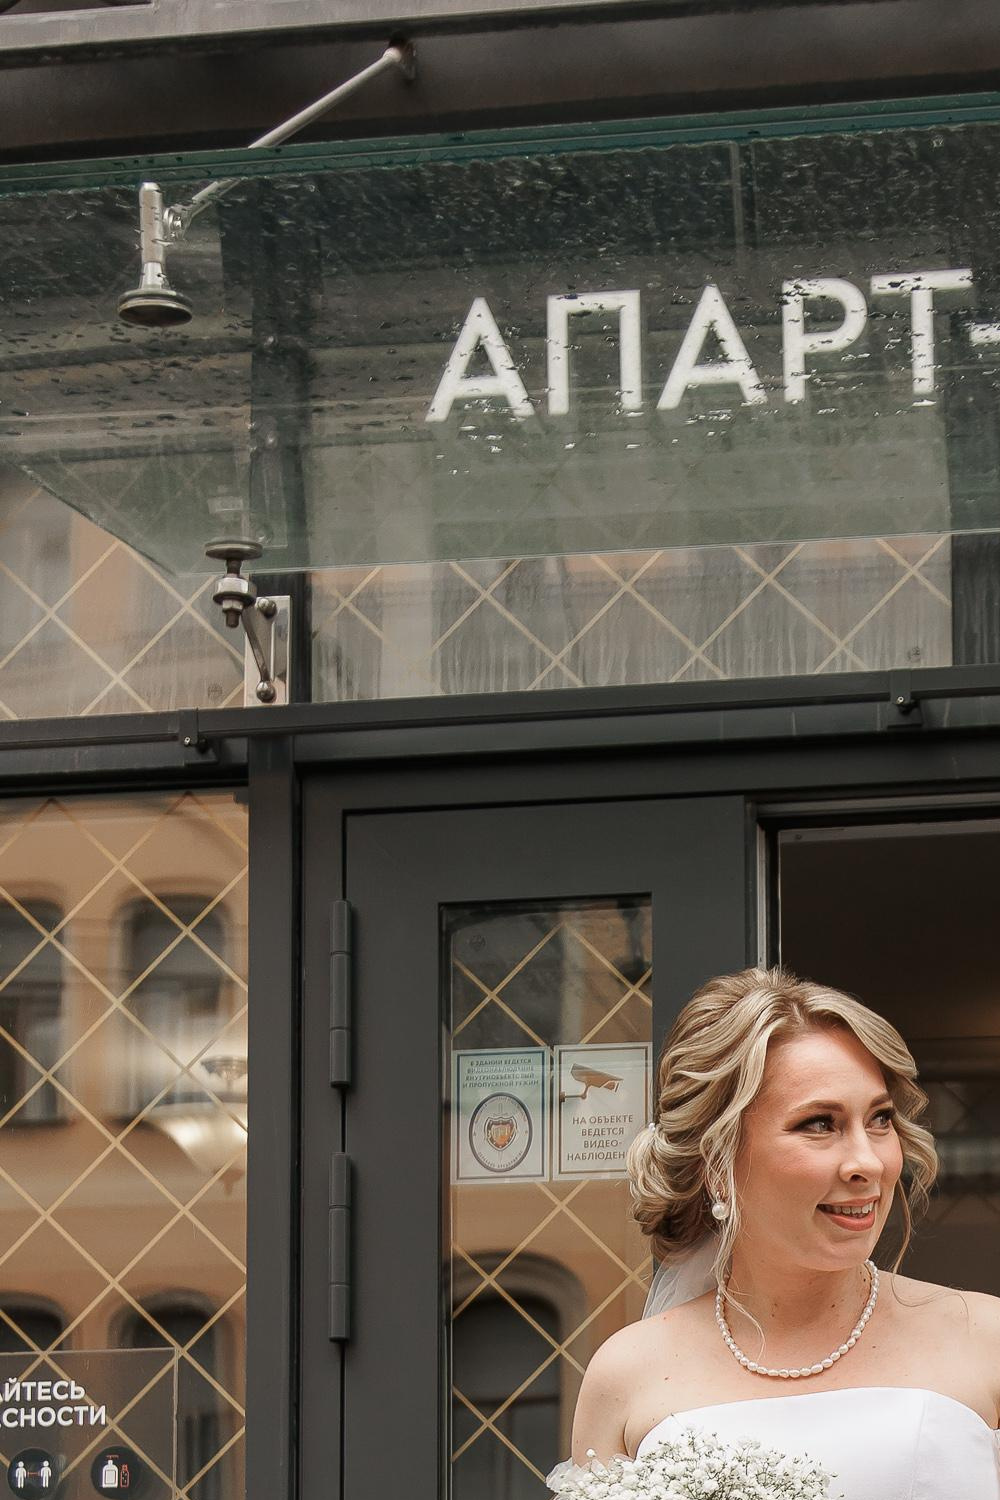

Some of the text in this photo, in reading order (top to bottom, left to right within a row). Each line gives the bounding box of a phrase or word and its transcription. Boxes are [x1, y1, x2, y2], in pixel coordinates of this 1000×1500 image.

[572, 1115, 633, 1125] НА ОБЪЕКТЕ
[581, 1127, 625, 1137] ВЕДЕТСЯ
[583, 1140, 622, 1149] ВИДЕО-
[567, 1151, 628, 1161] НАБЛЮДЕН
[0, 1377, 86, 1402] ЙТЕСЬ
[0, 1405, 106, 1428] СНОСТИ
